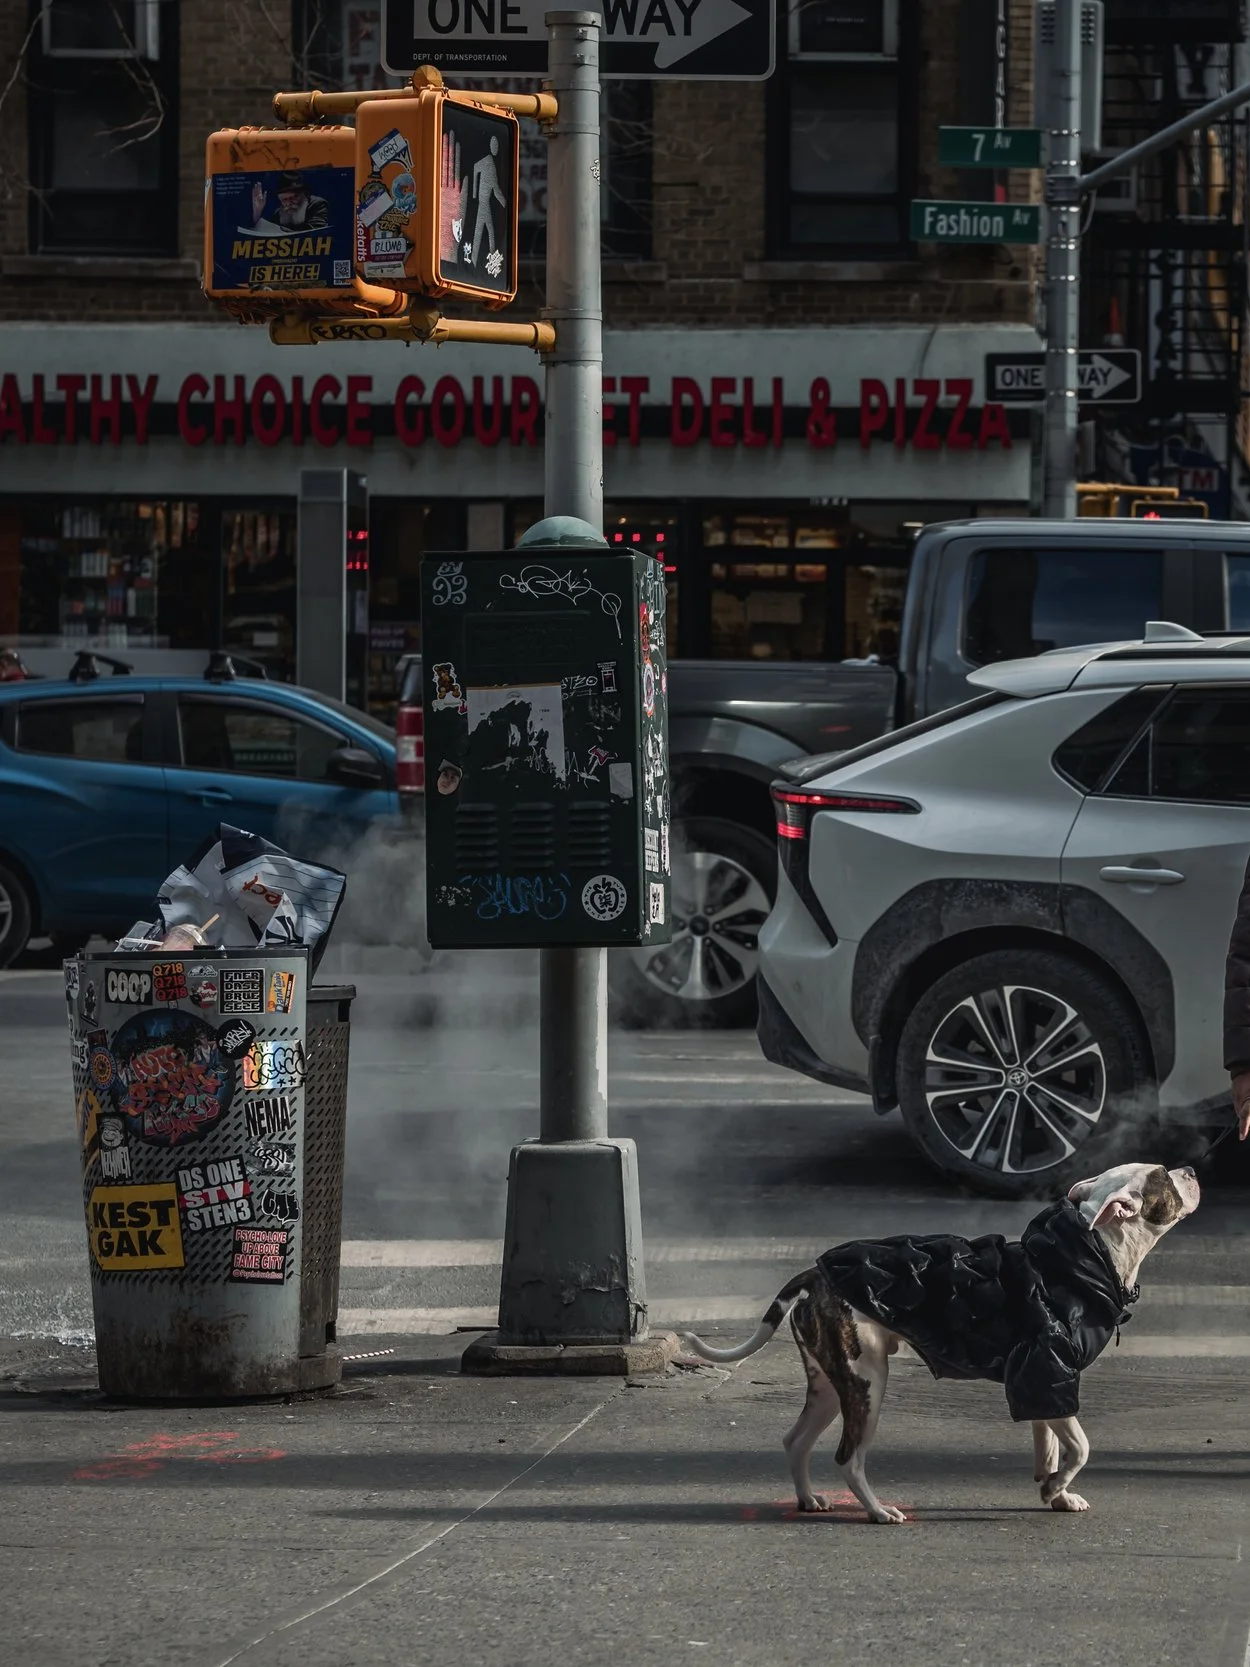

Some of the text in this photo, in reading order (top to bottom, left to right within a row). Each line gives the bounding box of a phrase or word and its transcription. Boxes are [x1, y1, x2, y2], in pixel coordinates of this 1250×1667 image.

[427, 0, 702, 36] ONE WAY
[434, 53, 444, 61] OF
[445, 53, 508, 62] TRANSPORTATION
[971, 131, 1012, 162] 7 Av
[924, 206, 1031, 238] Fashion Av
[231, 236, 332, 260] MESSIAH
[251, 264, 317, 281] IS HERE!
[1001, 367, 1042, 387] ONE
[178, 373, 373, 447] CHOICE
[394, 374, 650, 448] GOURET
[672, 376, 784, 448] DELI
[806, 375, 838, 448] &
[860, 377, 1013, 449] PIZZA
[108, 971, 152, 1002] COOP
[246, 1098, 291, 1136] NEMA
[179, 1167, 201, 1190] DS
[206, 1158, 243, 1184] ONE
[184, 1181, 245, 1209] STV
[92, 1200, 175, 1228] KEST
[187, 1198, 252, 1231] STEN3
[98, 1230, 166, 1258] GAK
[234, 1254, 284, 1270] FAME CITY
